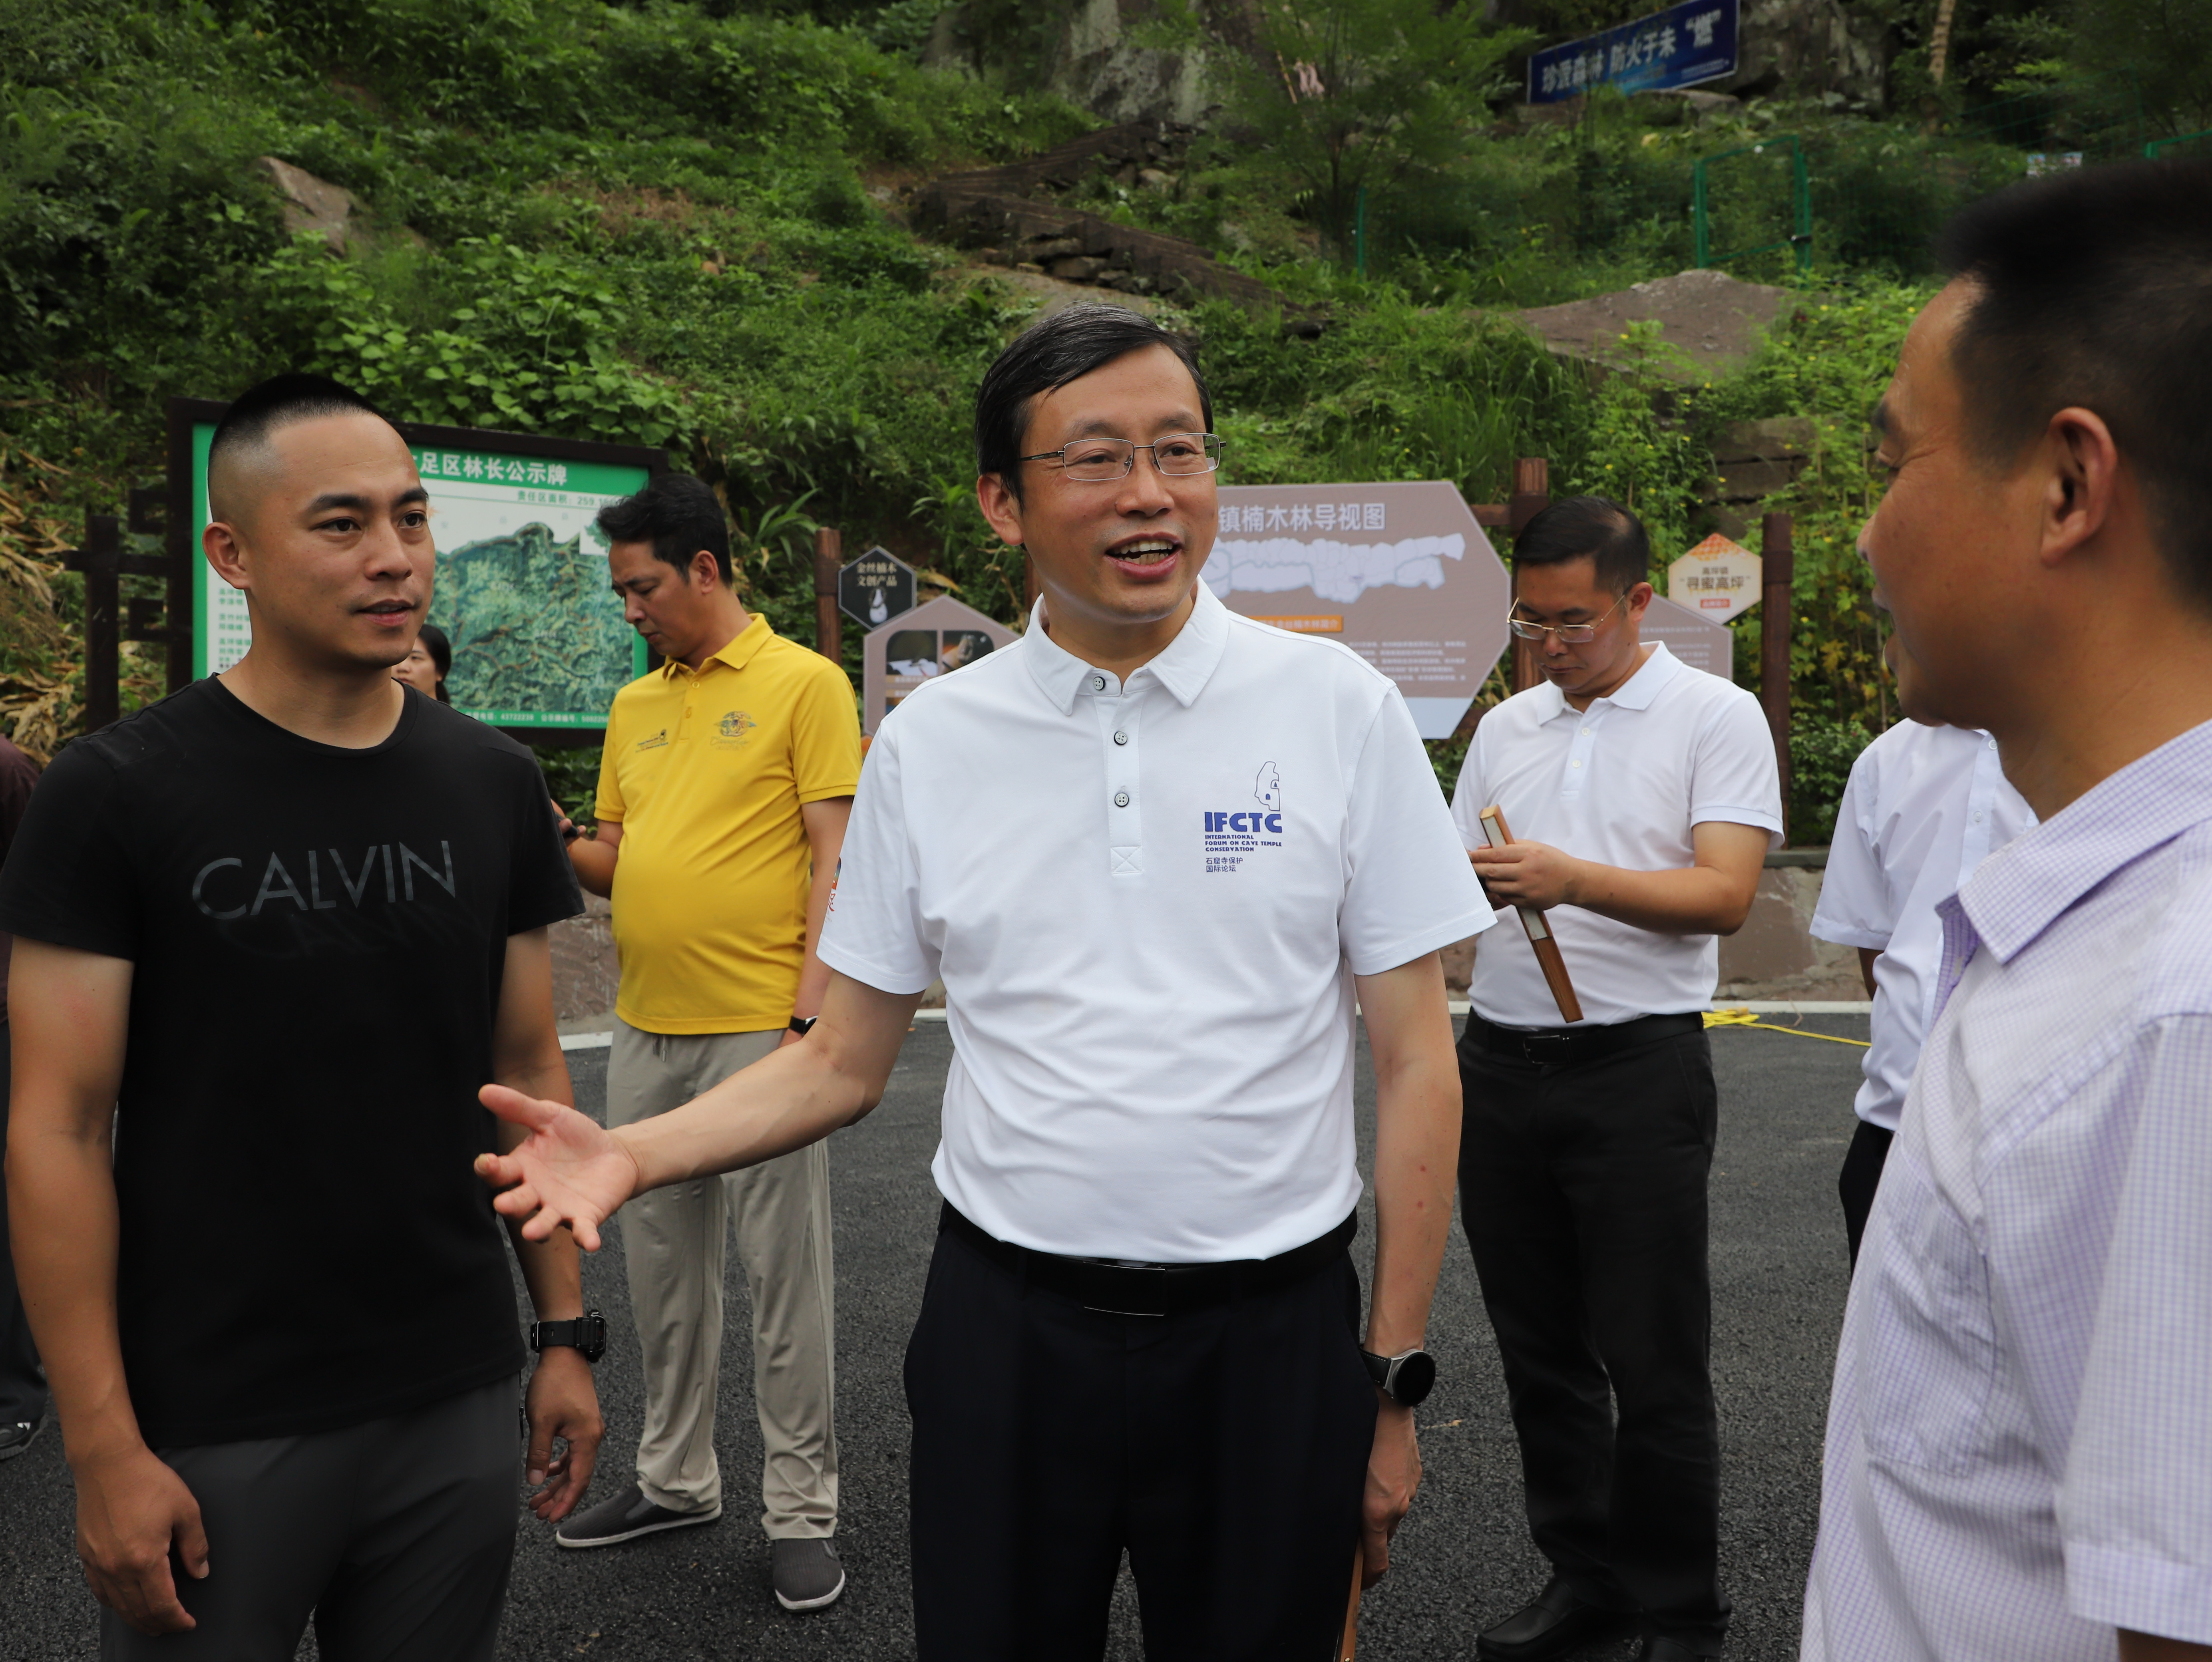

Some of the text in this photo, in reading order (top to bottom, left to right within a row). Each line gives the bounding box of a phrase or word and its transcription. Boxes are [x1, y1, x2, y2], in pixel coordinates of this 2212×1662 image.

[413, 451, 567, 486] 足区林长公示牌
[1219, 503, 1386, 533] 镇楠木林导视图
[857, 562, 897, 574] 金丝楠木
[857, 575, 897, 587] 文创产品
[1204, 811, 1282, 833] IFCTC
[192, 840, 456, 919] CALVIN
